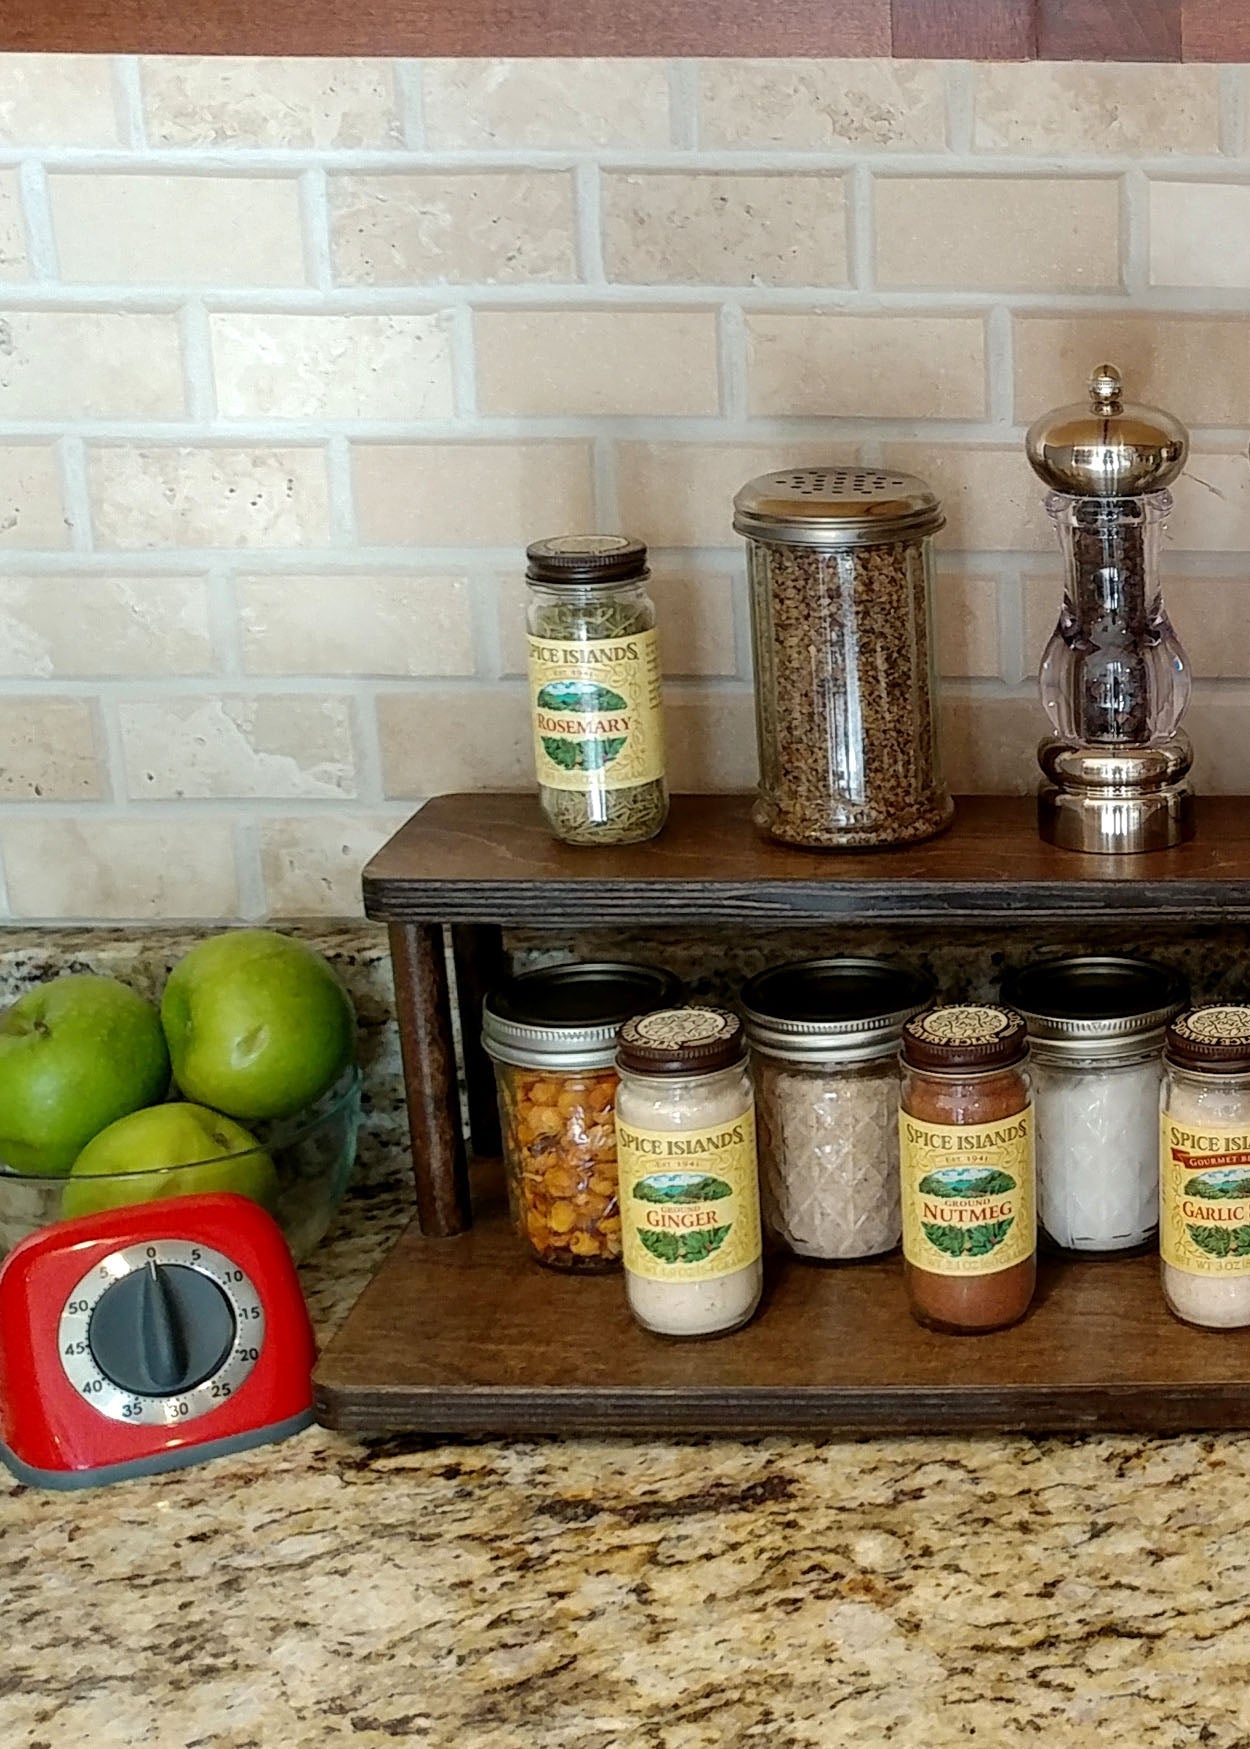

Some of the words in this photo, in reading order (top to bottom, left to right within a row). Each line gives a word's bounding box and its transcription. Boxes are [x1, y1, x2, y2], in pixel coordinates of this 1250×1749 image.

[529, 644, 559, 664] PICE
[563, 642, 639, 664] ISLANDS
[537, 713, 633, 734] ROSEMARY
[619, 1127, 662, 1155] SPICE
[667, 1124, 745, 1156] ISLANDS
[906, 1123, 953, 1150] SPICE
[957, 1119, 1028, 1150] ISLANDS
[1170, 1126, 1220, 1151] SPICE
[1189, 1155, 1238, 1167] GOURMET
[944, 1198, 991, 1207] GROUND
[923, 1201, 1012, 1222] NUTMEG
[1182, 1200, 1245, 1221] GARLIC
[646, 1210, 719, 1228] GINGER
[146, 1247, 156, 1259] 0
[191, 1249, 202, 1261] 5
[1224, 1261, 1241, 1271] OZ
[224, 1270, 244, 1283] 10
[68, 1300, 89, 1315] 50
[242, 1307, 260, 1320] 15
[65, 1342, 85, 1356] 45
[240, 1349, 259, 1362] 20
[82, 1381, 103, 1394] 40
[211, 1383, 232, 1398] 25
[122, 1403, 143, 1418] 35
[169, 1402, 189, 1418] 30
